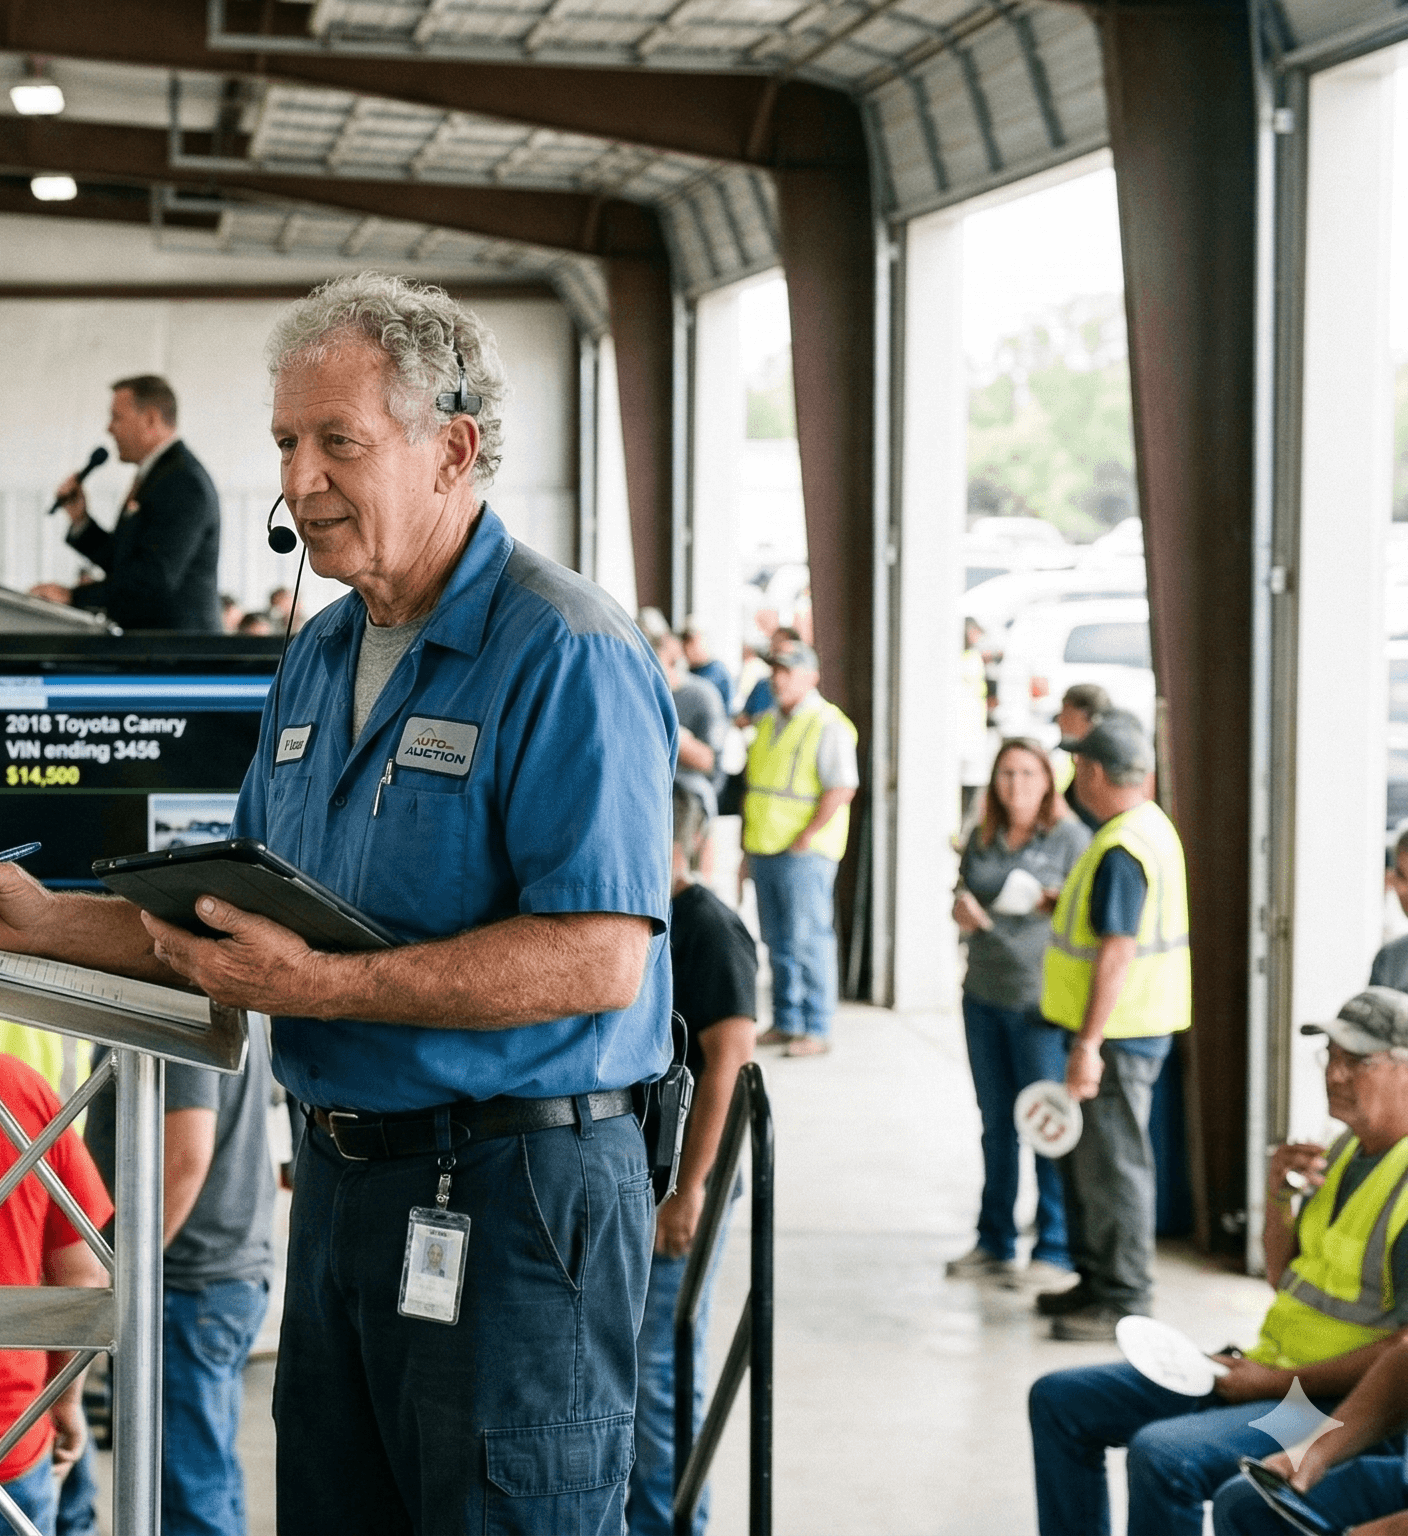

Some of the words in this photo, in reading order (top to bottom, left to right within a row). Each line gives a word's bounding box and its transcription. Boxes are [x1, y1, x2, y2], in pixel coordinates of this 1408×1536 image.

[5, 714, 52, 734] 2018
[55, 714, 120, 738] Toyota
[123, 714, 187, 738] Camry
[5, 740, 41, 760] VIN
[44, 740, 111, 764] ending
[113, 740, 161, 760] 3456
[412, 737, 447, 749] AUTO
[404, 746, 467, 765] AUCTION
[5, 765, 81, 788] $14,500
